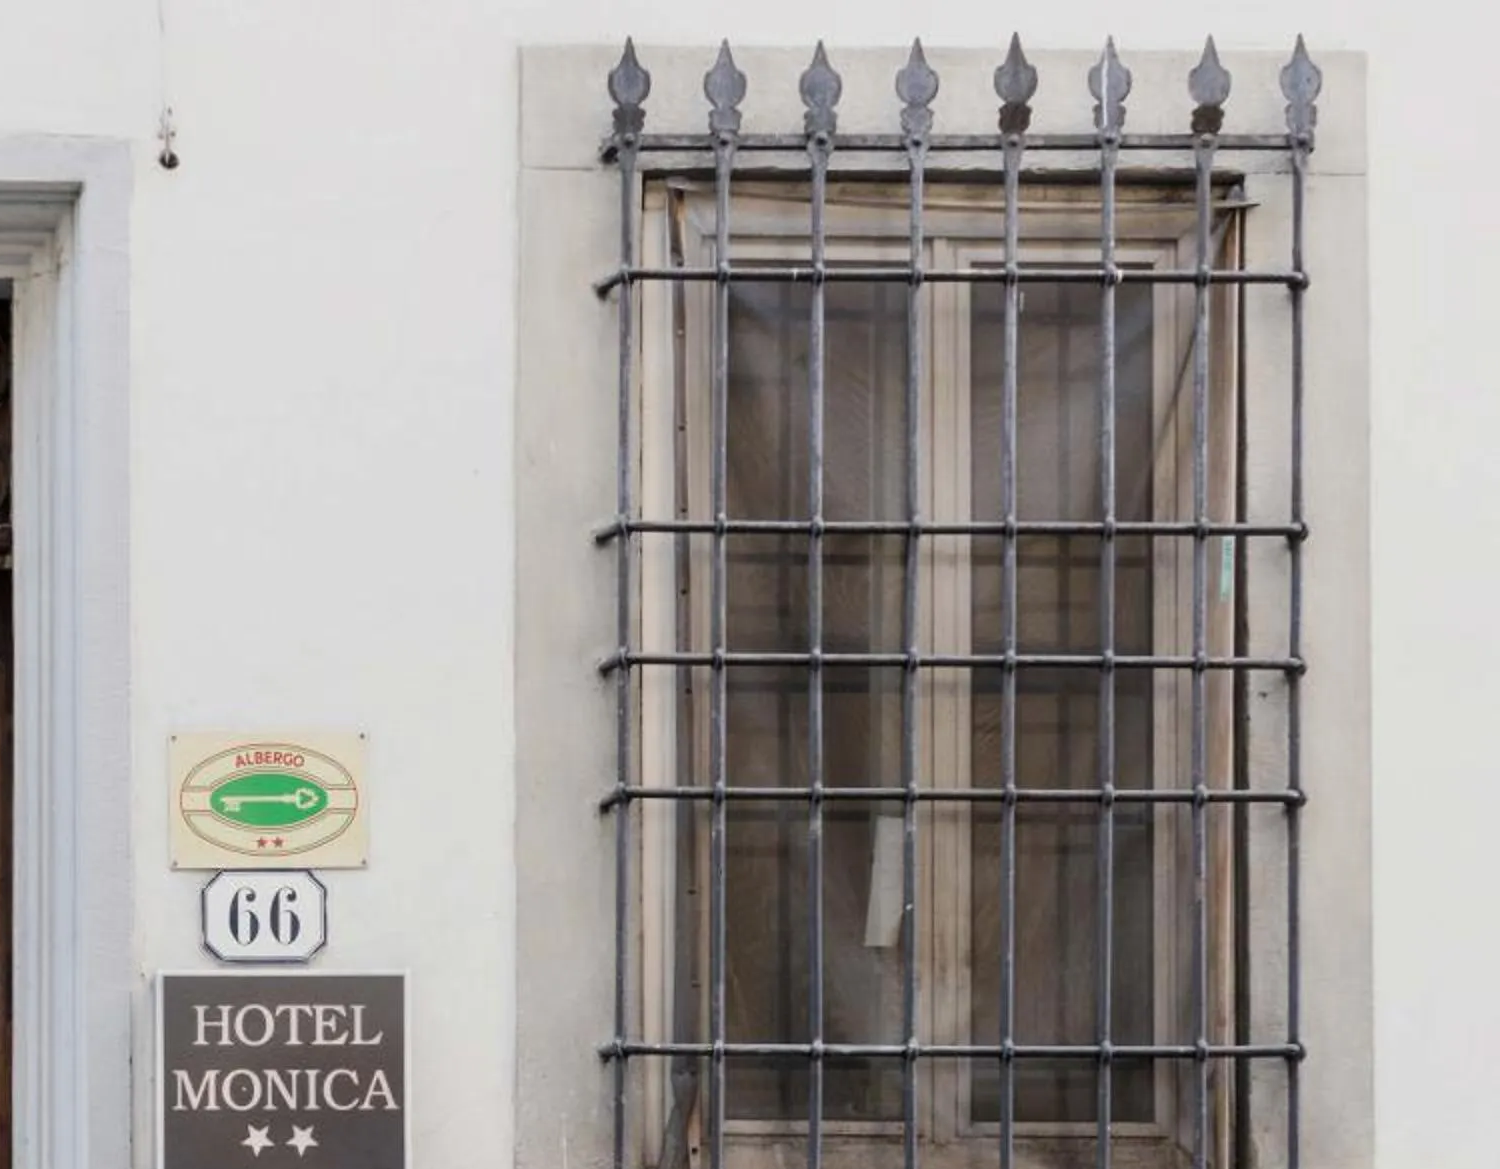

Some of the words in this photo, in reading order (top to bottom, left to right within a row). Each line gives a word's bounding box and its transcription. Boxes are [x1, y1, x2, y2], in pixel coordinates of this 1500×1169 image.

[235, 751, 305, 768] ALBERGO
[229, 886, 300, 946] 66
[192, 1003, 384, 1046] HOTEL
[172, 1069, 398, 1111] MONICA
